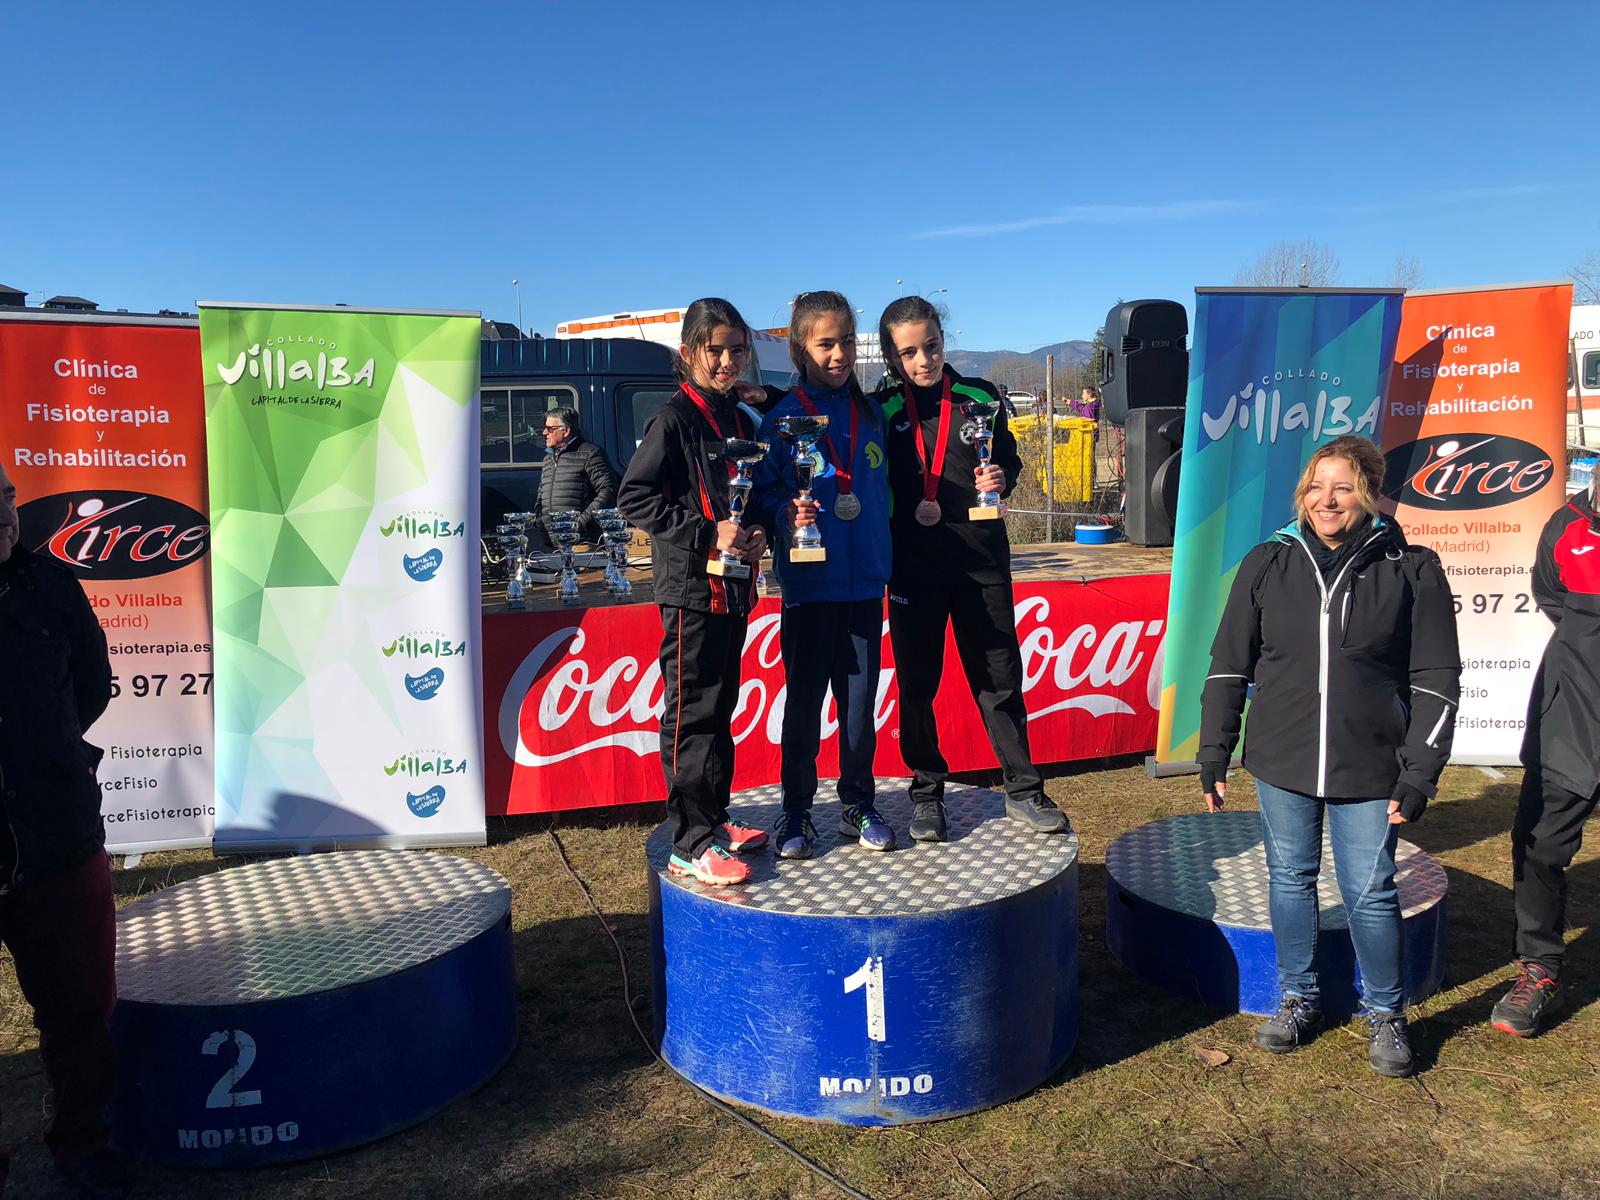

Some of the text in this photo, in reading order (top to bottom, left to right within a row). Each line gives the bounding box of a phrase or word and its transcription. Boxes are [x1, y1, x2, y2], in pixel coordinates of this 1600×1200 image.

[1426, 323, 1495, 341] Clínica
[1574, 330, 1594, 340] ADO
[266, 335, 337, 350] COLLADO
[1452, 344, 1468, 354] de
[53, 358, 138, 379] Clínica
[1402, 358, 1521, 379] Fisioterapia
[1262, 368, 1341, 386] COLLADO
[88, 383, 106, 395] de
[1456, 383, 1464, 392] y
[1391, 395, 1533, 417] Rehabilitación
[26, 403, 170, 427] Fisioterapia
[96, 430, 104, 442] y
[14, 447, 187, 468] Rehabilitación
[1402, 522, 1521, 536] Collado Villalba
[1430, 540, 1490, 554] (Madrid)
[1446, 564, 1535, 577] fisioterapia.e
[115, 593, 183, 608] Villalba
[1452, 593, 1540, 614] 5 97 2
[100, 614, 149, 631] adrid)
[110, 642, 211, 656] sioterapia.es
[1460, 658, 1531, 671] sioterapia
[110, 672, 214, 698] 5 97 27
[1460, 686, 1489, 698] Fisio
[1456, 716, 1526, 731] Fisioterap
[111, 744, 202, 760] Fisioterapia
[99, 776, 158, 790] rceFisio
[101, 805, 215, 823] rceFisioterapia
[843, 956, 886, 1042] 1
[201, 1029, 263, 1109] 2
